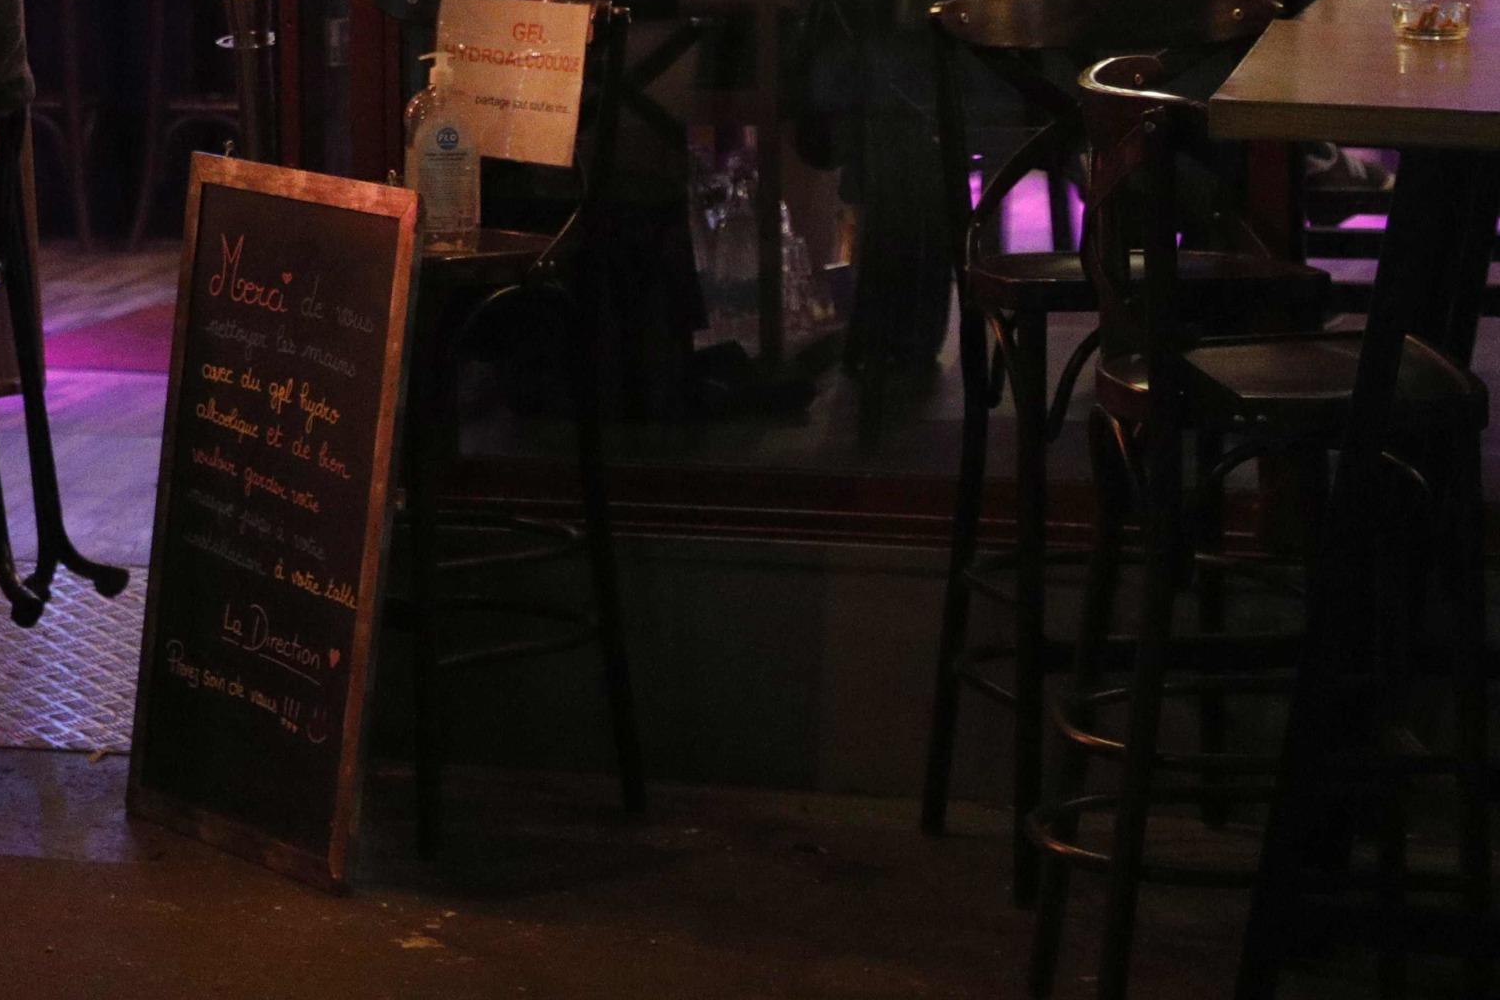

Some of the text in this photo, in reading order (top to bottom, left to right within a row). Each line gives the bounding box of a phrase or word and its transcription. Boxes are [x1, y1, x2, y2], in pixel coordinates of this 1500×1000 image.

[208, 232, 289, 313] Merci
[299, 273, 324, 320] de
[201, 362, 341, 434] avec du gel hydro
[266, 424, 284, 448] et
[291, 435, 311, 460] de
[290, 570, 322, 596] votre
[324, 576, 358, 610] table
[242, 602, 321, 670] Direction
